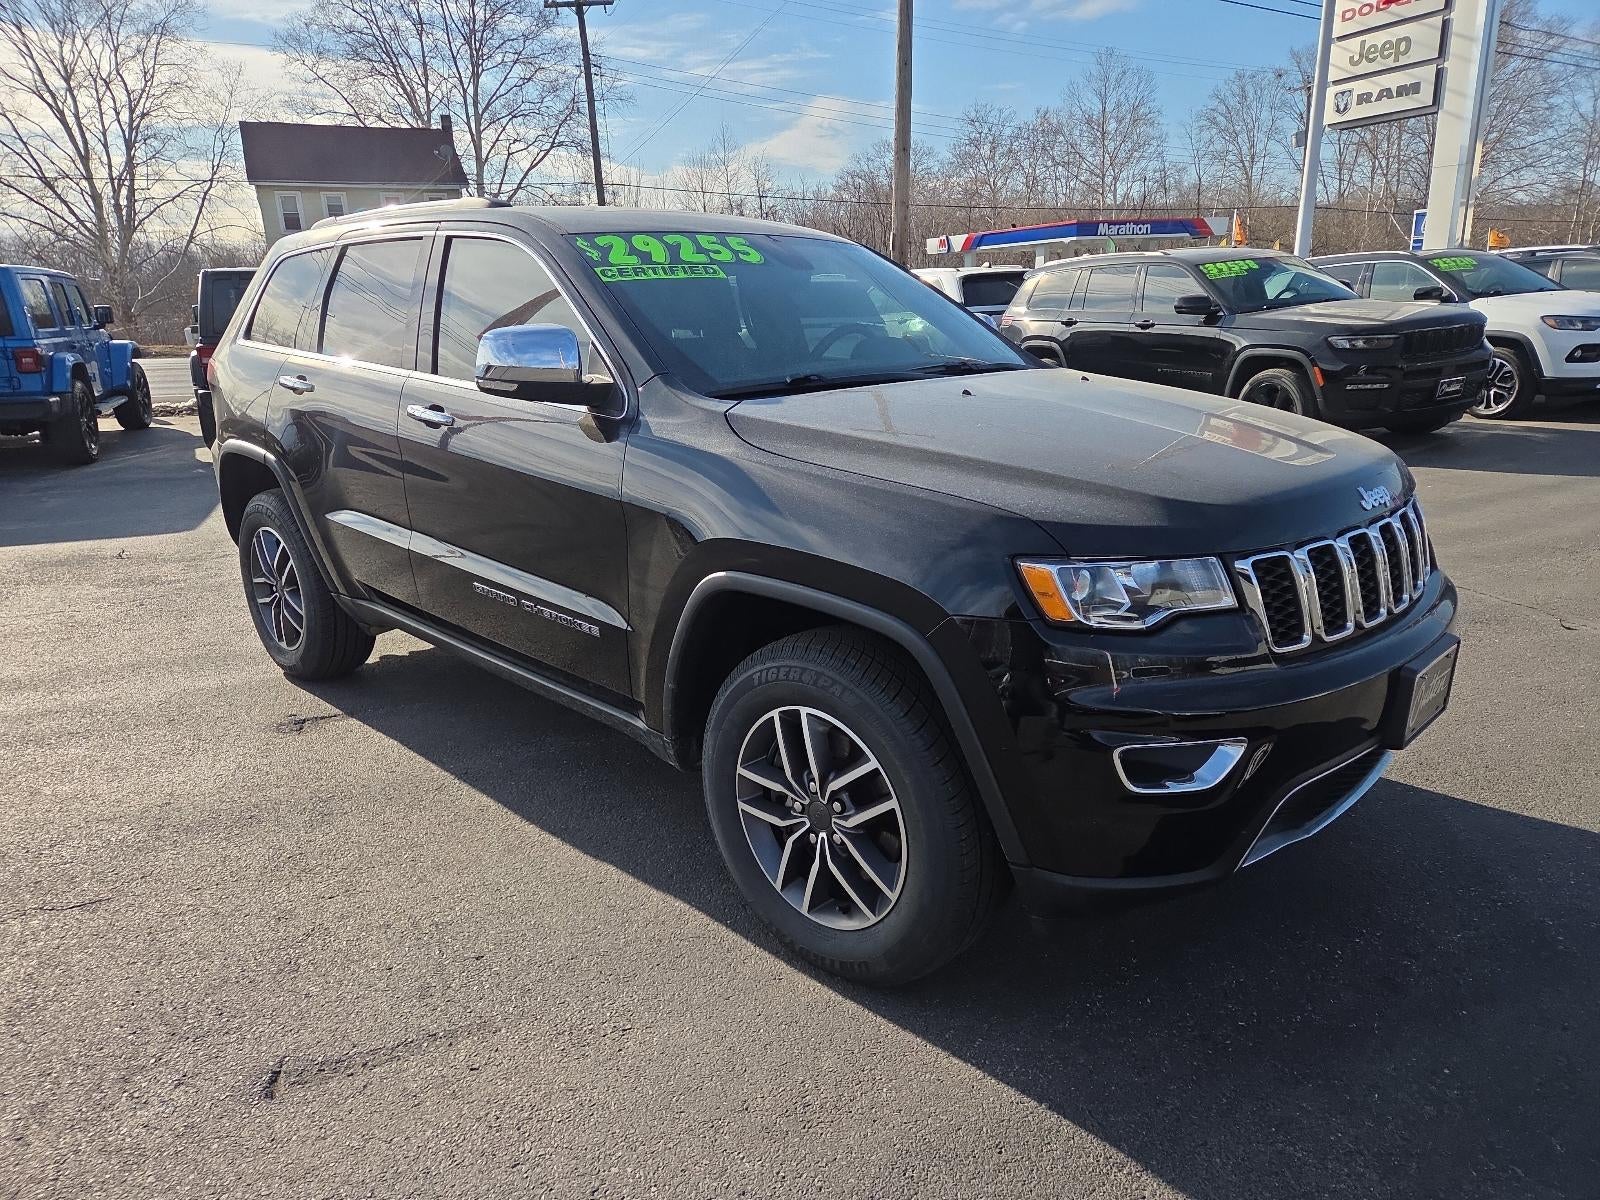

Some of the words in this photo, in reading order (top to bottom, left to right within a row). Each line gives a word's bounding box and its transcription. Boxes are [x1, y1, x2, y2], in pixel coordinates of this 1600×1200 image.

[1341, 0, 1412, 22] DOD
[1349, 36, 1412, 66] Jeep
[1356, 81, 1421, 106] RAM
[1097, 222, 1151, 236] Marathon
[576, 234, 764, 264] $29255
[599, 265, 720, 280] CERTIFIED
[1357, 485, 1391, 510] Jeep
[752, 666, 799, 686] TIGER
